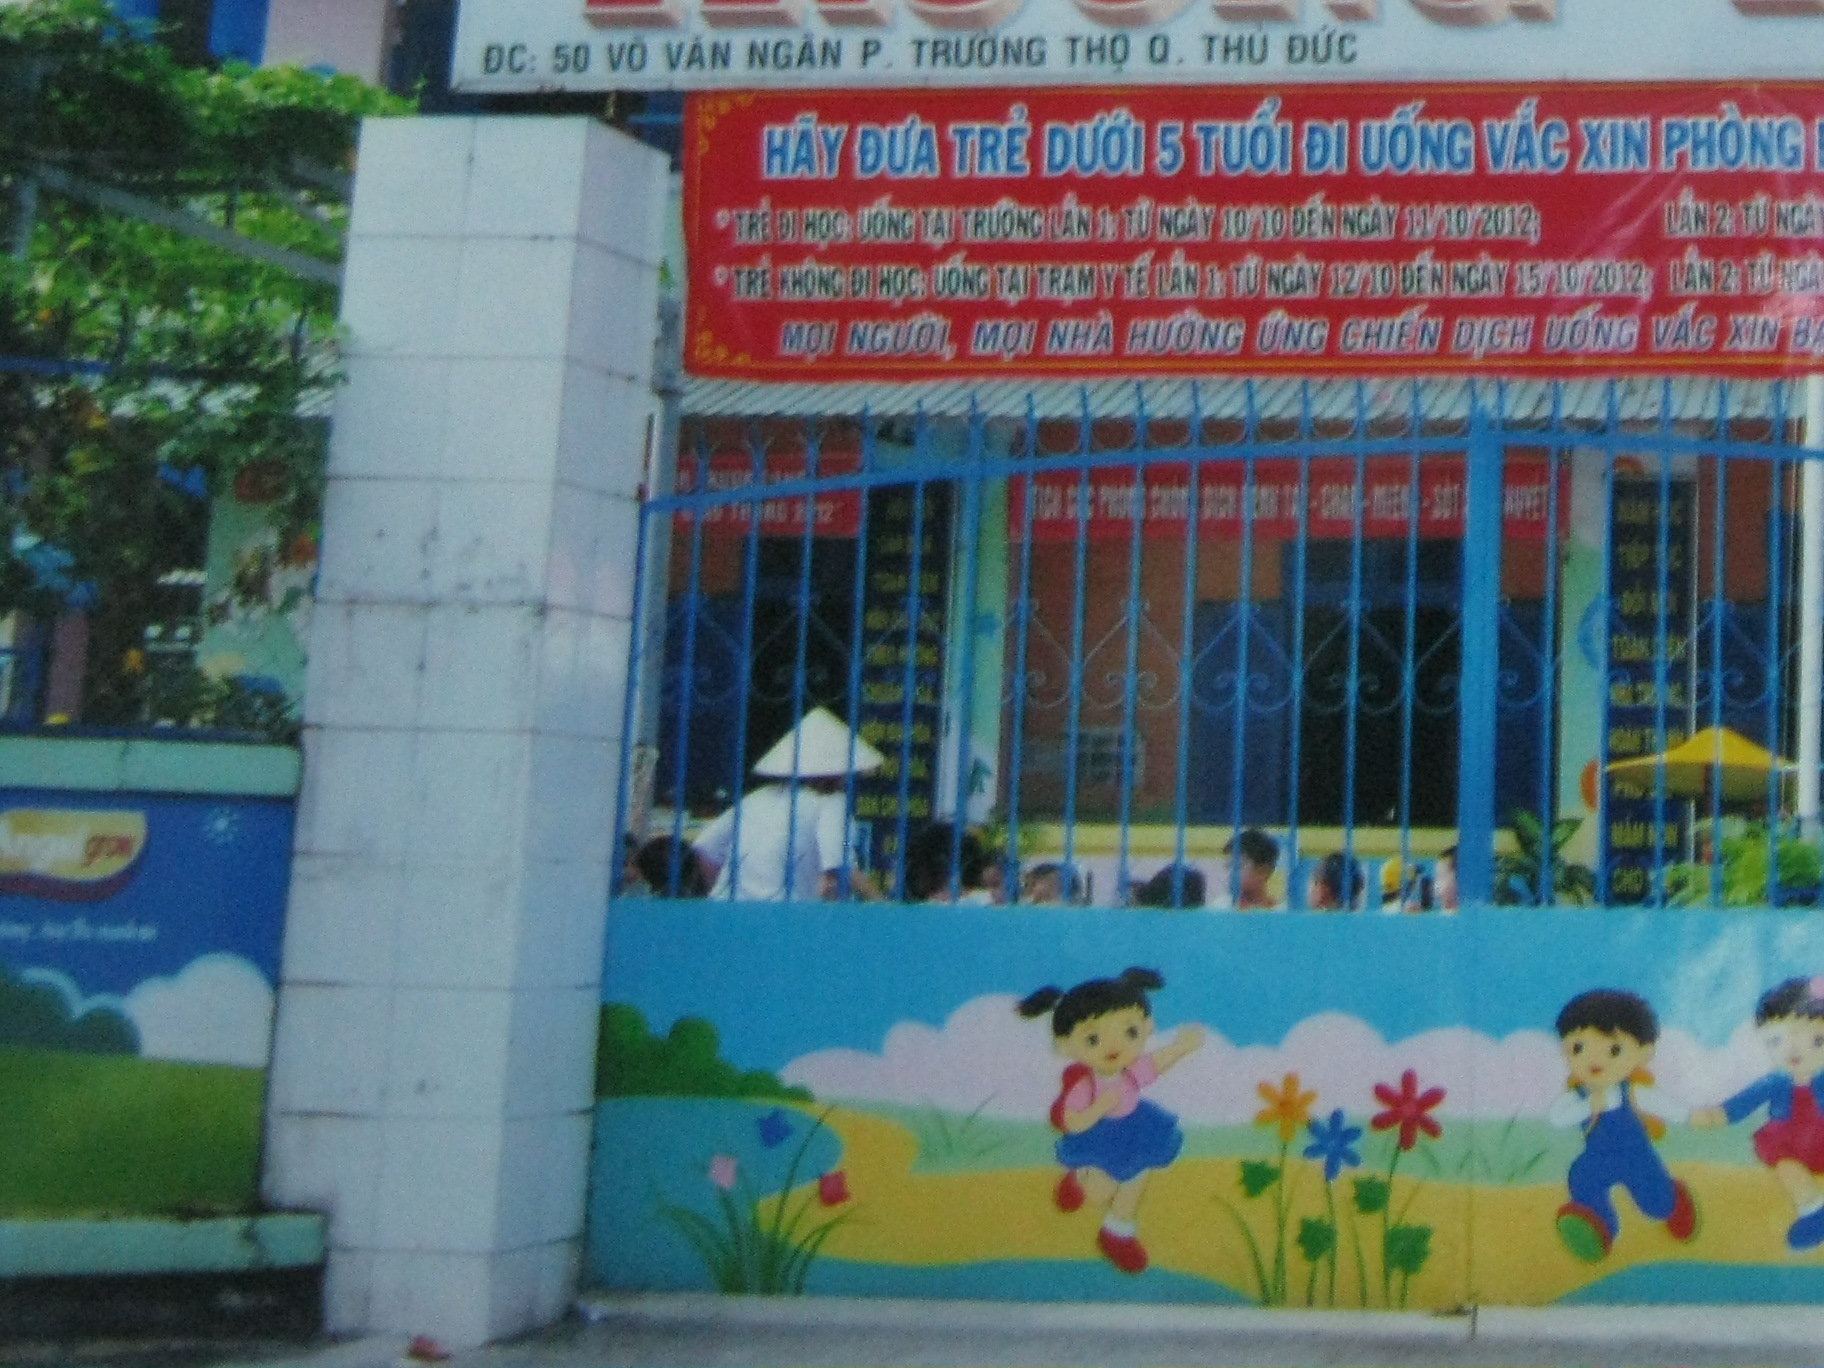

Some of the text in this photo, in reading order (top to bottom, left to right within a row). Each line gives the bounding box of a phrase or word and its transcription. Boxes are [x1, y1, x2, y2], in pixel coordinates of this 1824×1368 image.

[552, 43, 591, 73] 50
[1064, 32, 1131, 73] THỌ
[1287, 25, 1358, 65] ĐỨC
[762, 111, 848, 179] HÃY
[853, 113, 940, 179] ĐƯA
[948, 103, 1031, 178] TRẺ
[1043, 107, 1146, 178] DƯỚI
[1155, 121, 1185, 178] 5
[1194, 96, 1294, 176] TUỔI
[1304, 119, 1349, 175] ĐI
[1360, 100, 1477, 174] UỐNG
[1484, 97, 1571, 174] VẮC
[1577, 118, 1654, 173] XIN
[1661, 101, 1804, 173] PHÒNG
[732, 195, 772, 244] TRẺ
[776, 206, 799, 243] ĐI
[856, 192, 916, 243] UỐNG
[919, 206, 956, 250] TẠI
[1156, 195, 1217, 241] NGÀY
[1219, 204, 1288, 242] 10/10
[1339, 192, 1399, 241] NGÀY
[731, 251, 772, 301] TRẺ
[777, 255, 847, 301] KHÔNG
[931, 251, 991, 299] UỐNG
[994, 264, 1032, 306] TẠI
[1034, 264, 1099, 306] TRẠM
[1100, 264, 1119, 299] Y
[1120, 249, 1156, 299] TẾ
[1264, 252, 1324, 299] NGÀY
[1450, 251, 1509, 298] NGÀY
[780, 320, 839, 364] MỌI
[972, 319, 1039, 362] MỌI
[1045, 308, 1114, 356] NHÀ
[1338, 303, 1445, 354] CHIẾN
[1453, 315, 1536, 360] DỊCH
[1543, 302, 1641, 354] UỐNG
[1721, 315, 1784, 352] XIN
